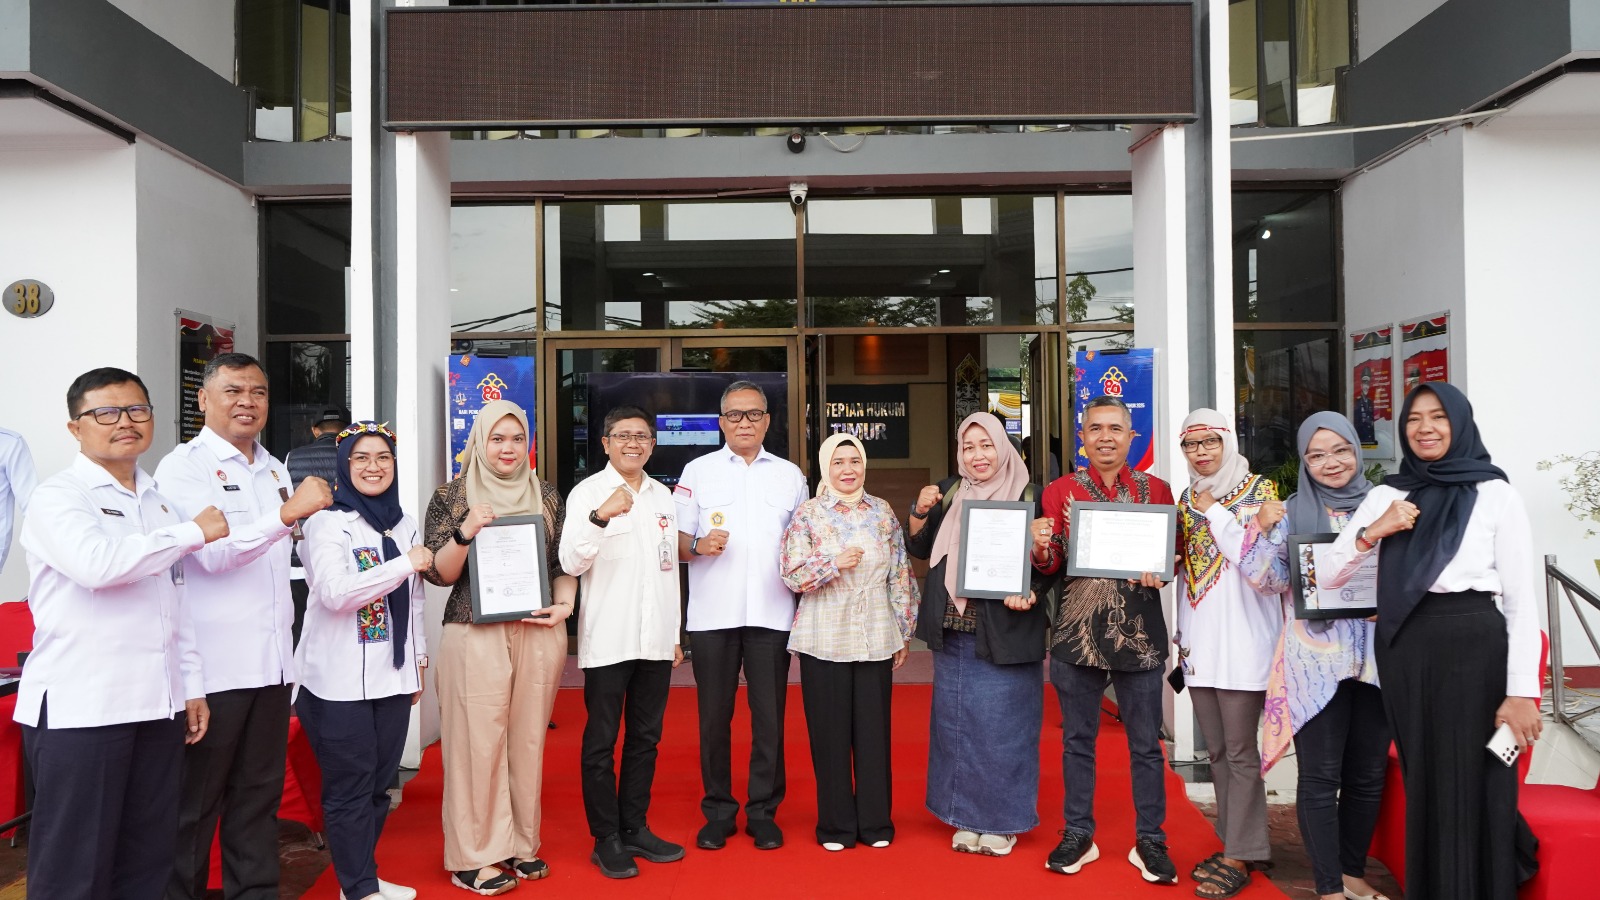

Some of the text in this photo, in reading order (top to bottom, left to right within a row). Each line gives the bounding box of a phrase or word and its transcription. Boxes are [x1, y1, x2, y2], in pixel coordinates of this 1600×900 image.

[13, 283, 40, 314] 38
[866, 402, 905, 417] HUKUM
[830, 422, 888, 440] TIMUR
